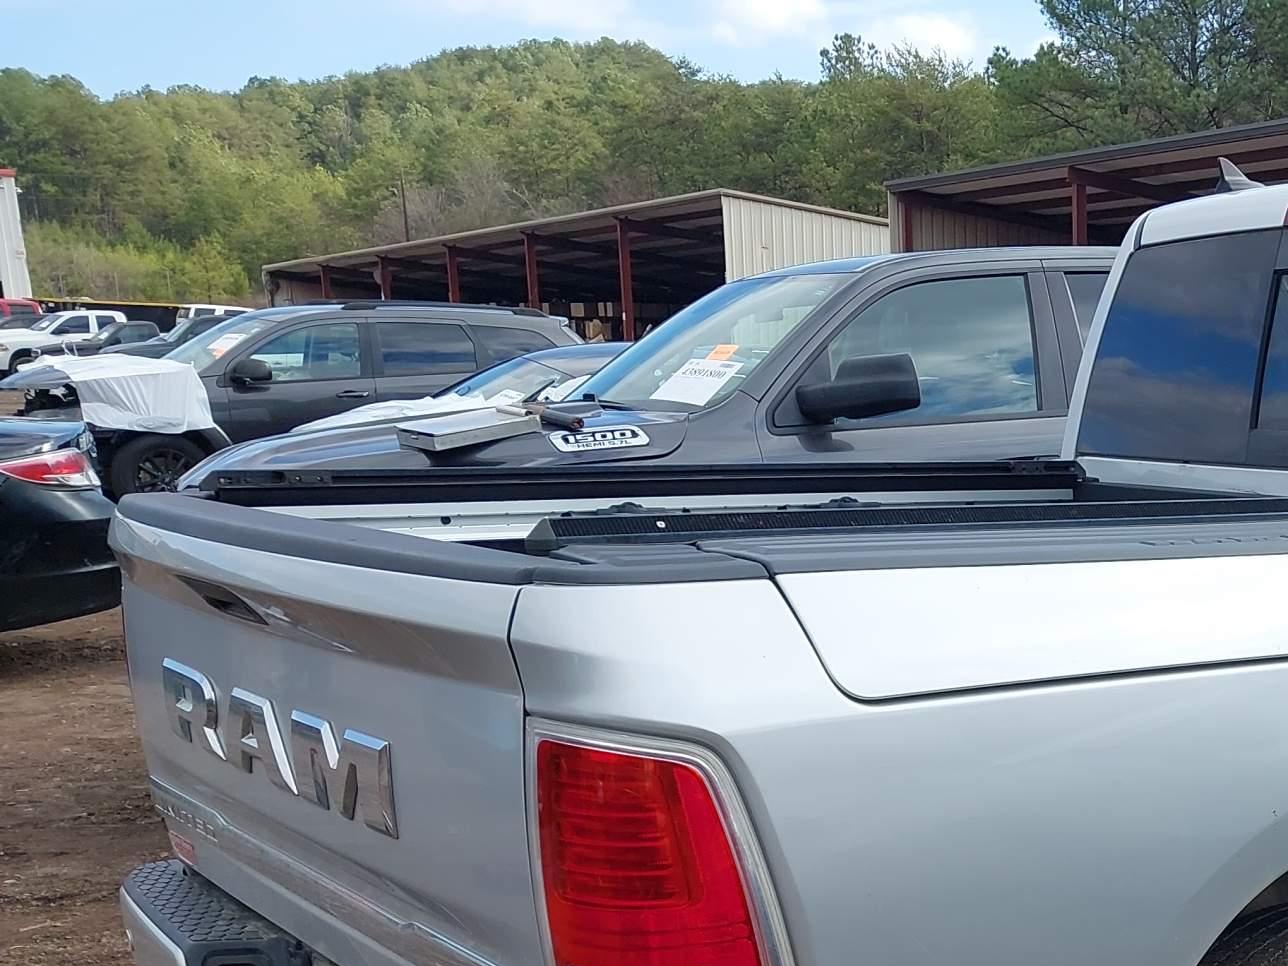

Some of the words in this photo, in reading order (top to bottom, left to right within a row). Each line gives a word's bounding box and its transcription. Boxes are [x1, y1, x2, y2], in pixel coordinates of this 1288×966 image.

[564, 429, 633, 444] 1500
[577, 441, 606, 449] HEMI
[160, 657, 399, 840] RAM
